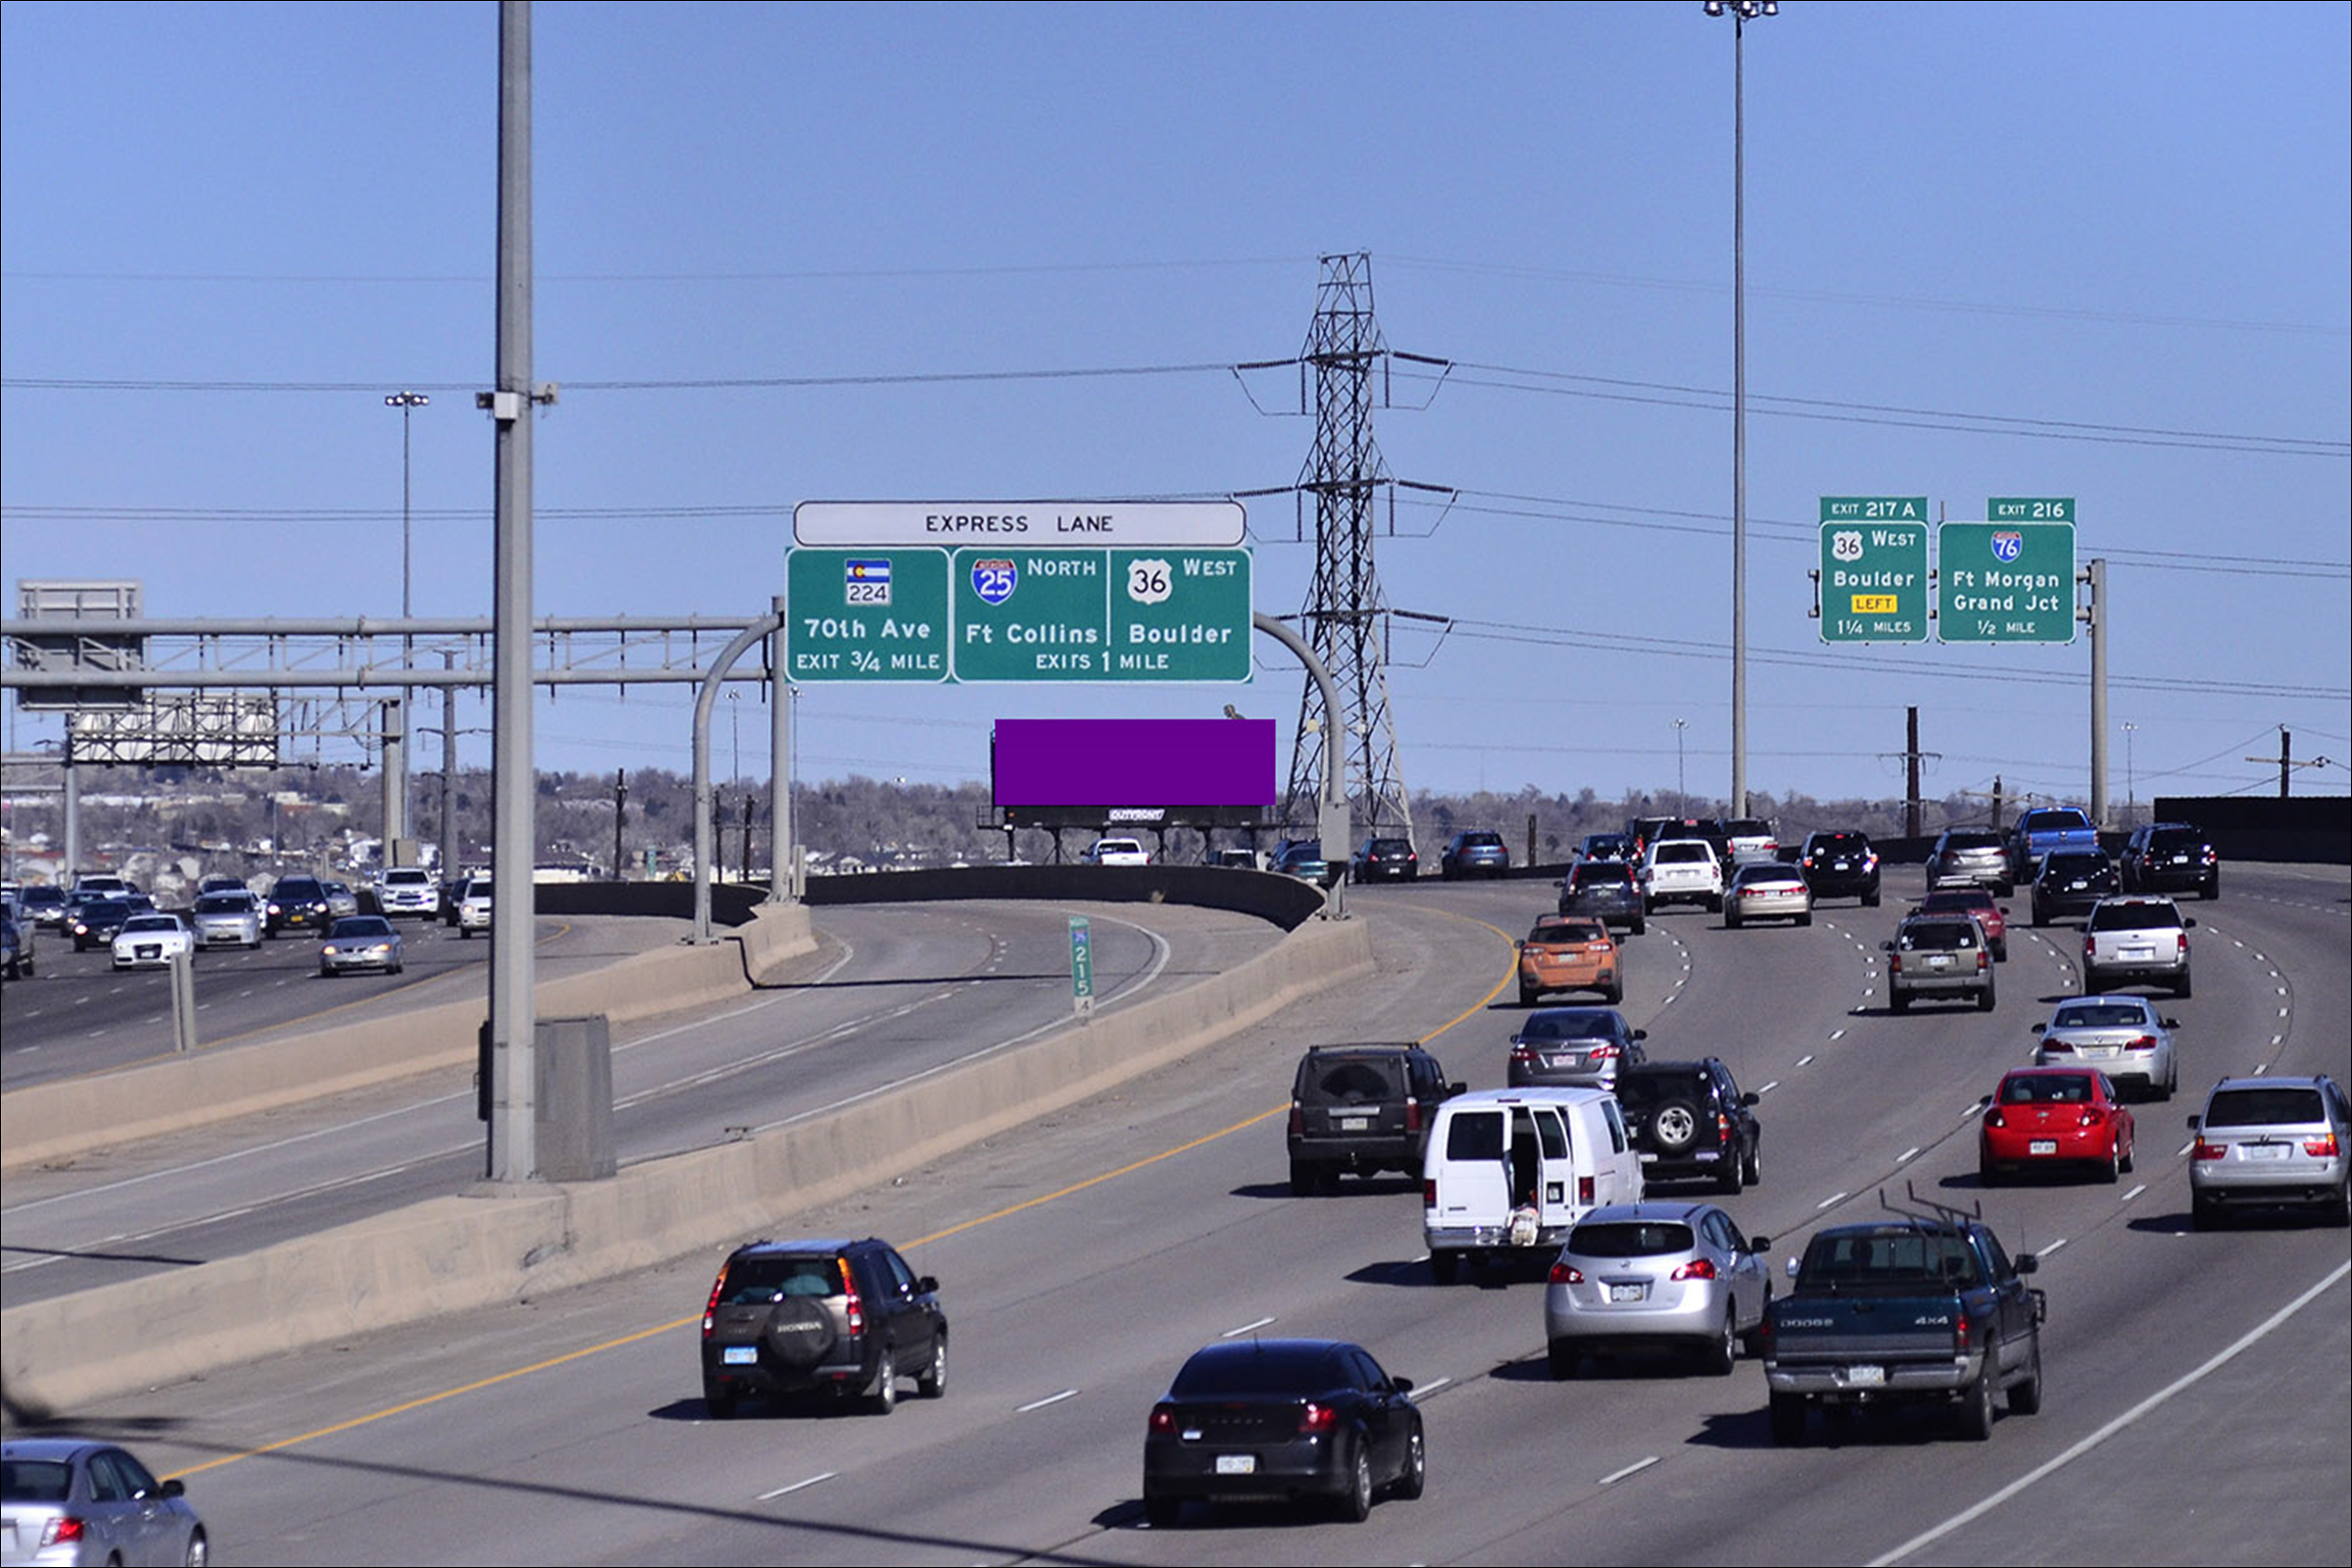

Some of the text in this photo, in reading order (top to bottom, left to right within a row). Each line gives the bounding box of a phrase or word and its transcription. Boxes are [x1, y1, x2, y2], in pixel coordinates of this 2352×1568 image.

[1832, 503, 1916, 516] EXIT 217 A
[1998, 503, 2065, 517] EXIT 216
[926, 515, 1113, 532] EXPRESS LANE
[1872, 530, 1916, 546] WEST
[1837, 539, 1859, 555] 36
[1995, 540, 2018, 557] 76
[1027, 559, 1097, 576] NORTH
[1183, 558, 1237, 576] WEST
[980, 570, 1012, 596] 25
[1134, 568, 1166, 593] 36
[1834, 570, 1915, 587] Boulder
[1953, 571, 2059, 592] Ft Morgan
[849, 585, 887, 602] 224
[1855, 599, 1892, 610] LEFT
[1954, 595, 2059, 611] Grand Jct
[804, 618, 931, 638] 70th Ave
[966, 623, 1099, 644] Ft Collins
[1129, 624, 1232, 643] Boulder
[1874, 621, 1911, 632] MILES
[2006, 622, 2035, 633] MILE
[796, 655, 840, 669] EXIT
[891, 655, 940, 669] MILE
[1102, 651, 1109, 672] 1
[1119, 654, 1169, 669] MILE
[777, 1321, 822, 1333] HONDA
